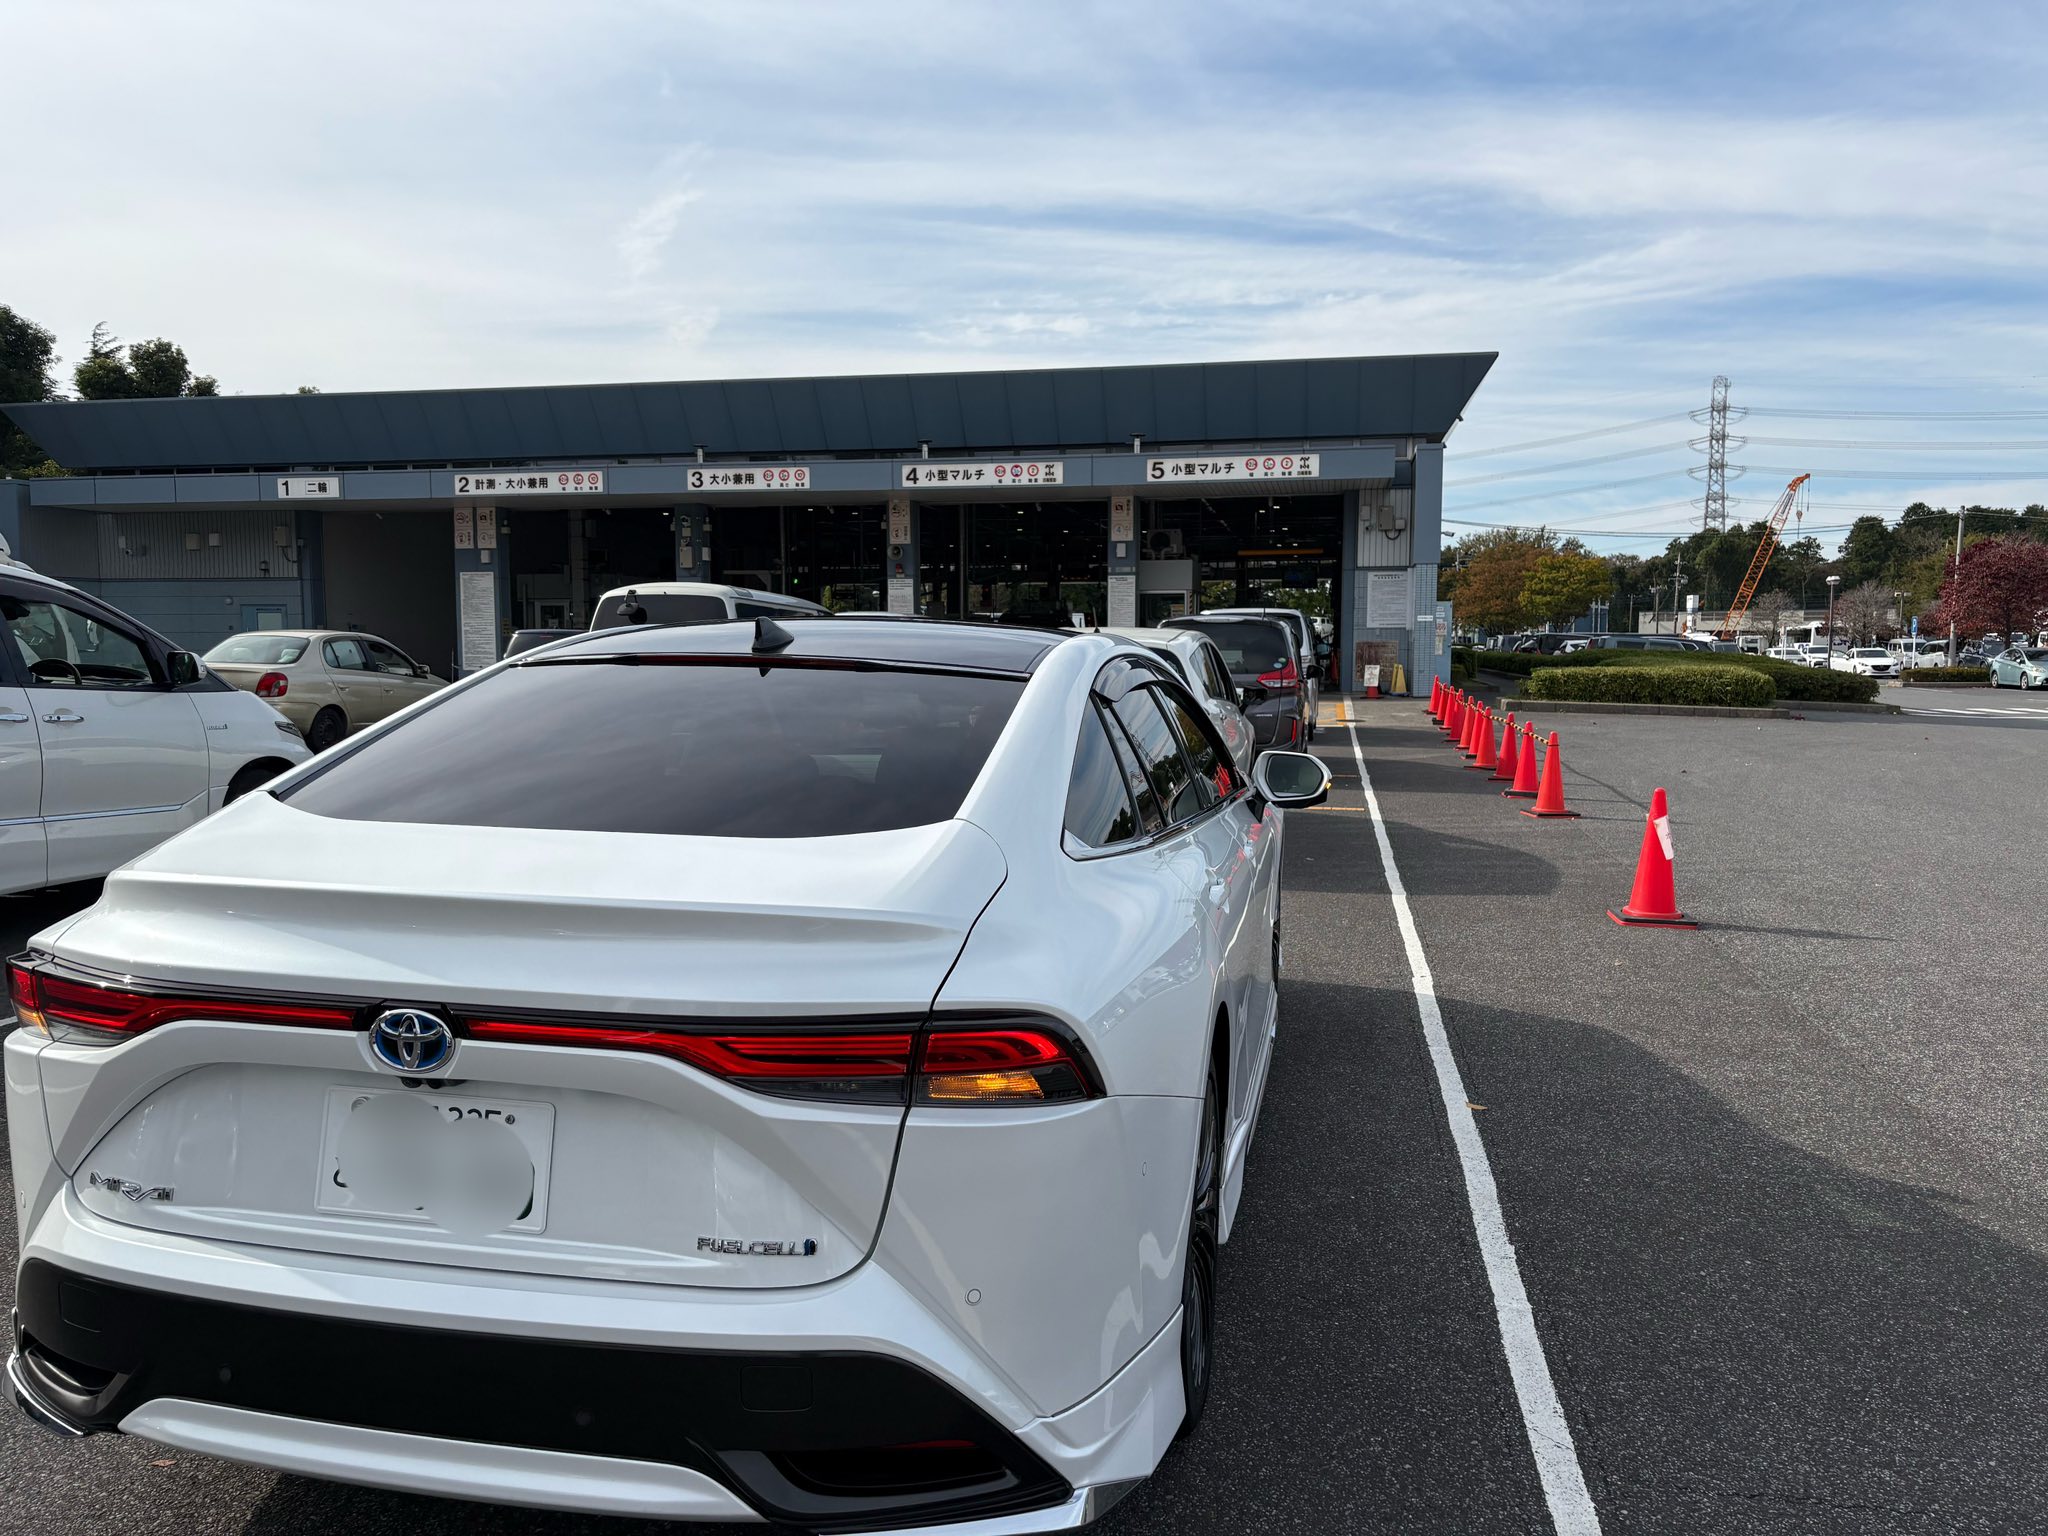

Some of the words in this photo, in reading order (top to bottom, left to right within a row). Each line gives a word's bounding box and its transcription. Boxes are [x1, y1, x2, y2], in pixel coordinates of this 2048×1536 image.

[905, 467, 919, 484] 4
[925, 468, 985, 481] 小型マルチ
[1151, 462, 1165, 479] 5
[1171, 462, 1235, 475] 小型マルチ
[281, 480, 289, 496] 1
[307, 482, 327, 493] 二輪
[458, 477, 470, 493] 2
[475, 477, 549, 490] 計測・大小兼用
[691, 471, 704, 488] 3
[709, 473, 755, 485] 大小兼用
[89, 1170, 175, 1202] MIRAI
